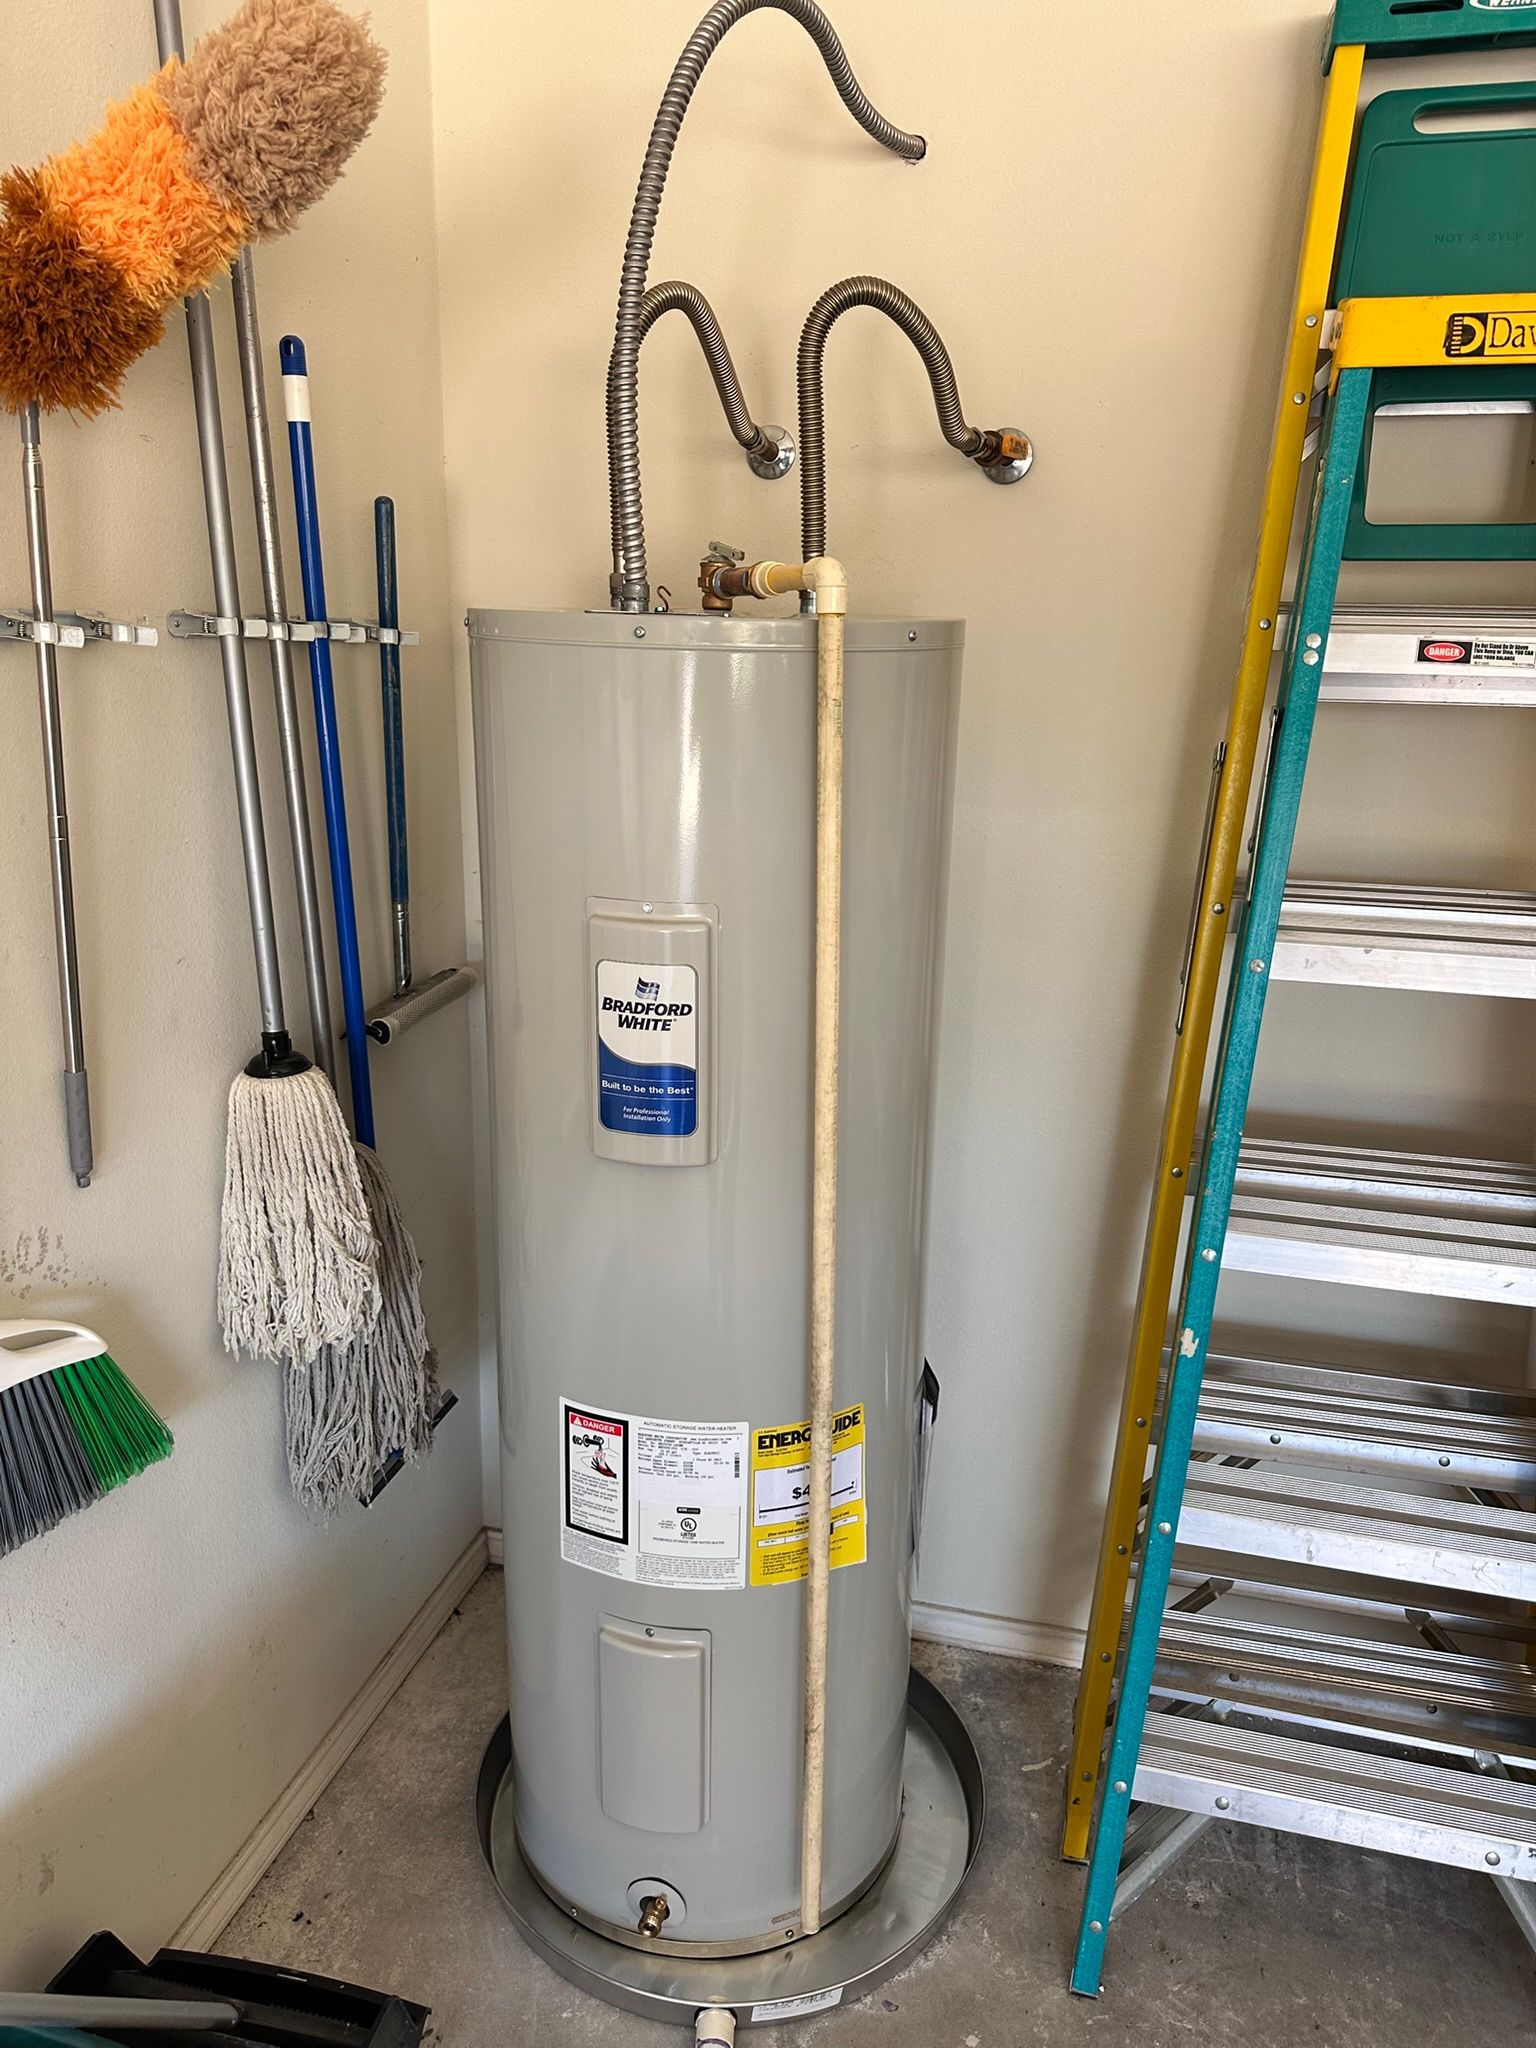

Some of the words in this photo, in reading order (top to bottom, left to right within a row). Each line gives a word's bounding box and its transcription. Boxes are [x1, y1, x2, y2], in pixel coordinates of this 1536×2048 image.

[1428, 647, 1460, 657] DANGER
[601, 996, 693, 1016] BRADFORD
[601, 1079, 621, 1090] Built
[622, 1082, 632, 1092] to
[633, 1084, 646, 1094] be
[649, 1085, 665, 1094] the
[622, 1105, 633, 1113] For
[633, 1106, 670, 1115] Professional
[623, 1113, 656, 1122] Installation
[657, 1115, 671, 1123] Only
[582, 1419, 616, 1434] DANGER
[643, 1421, 672, 1429] AUTOMATIC
